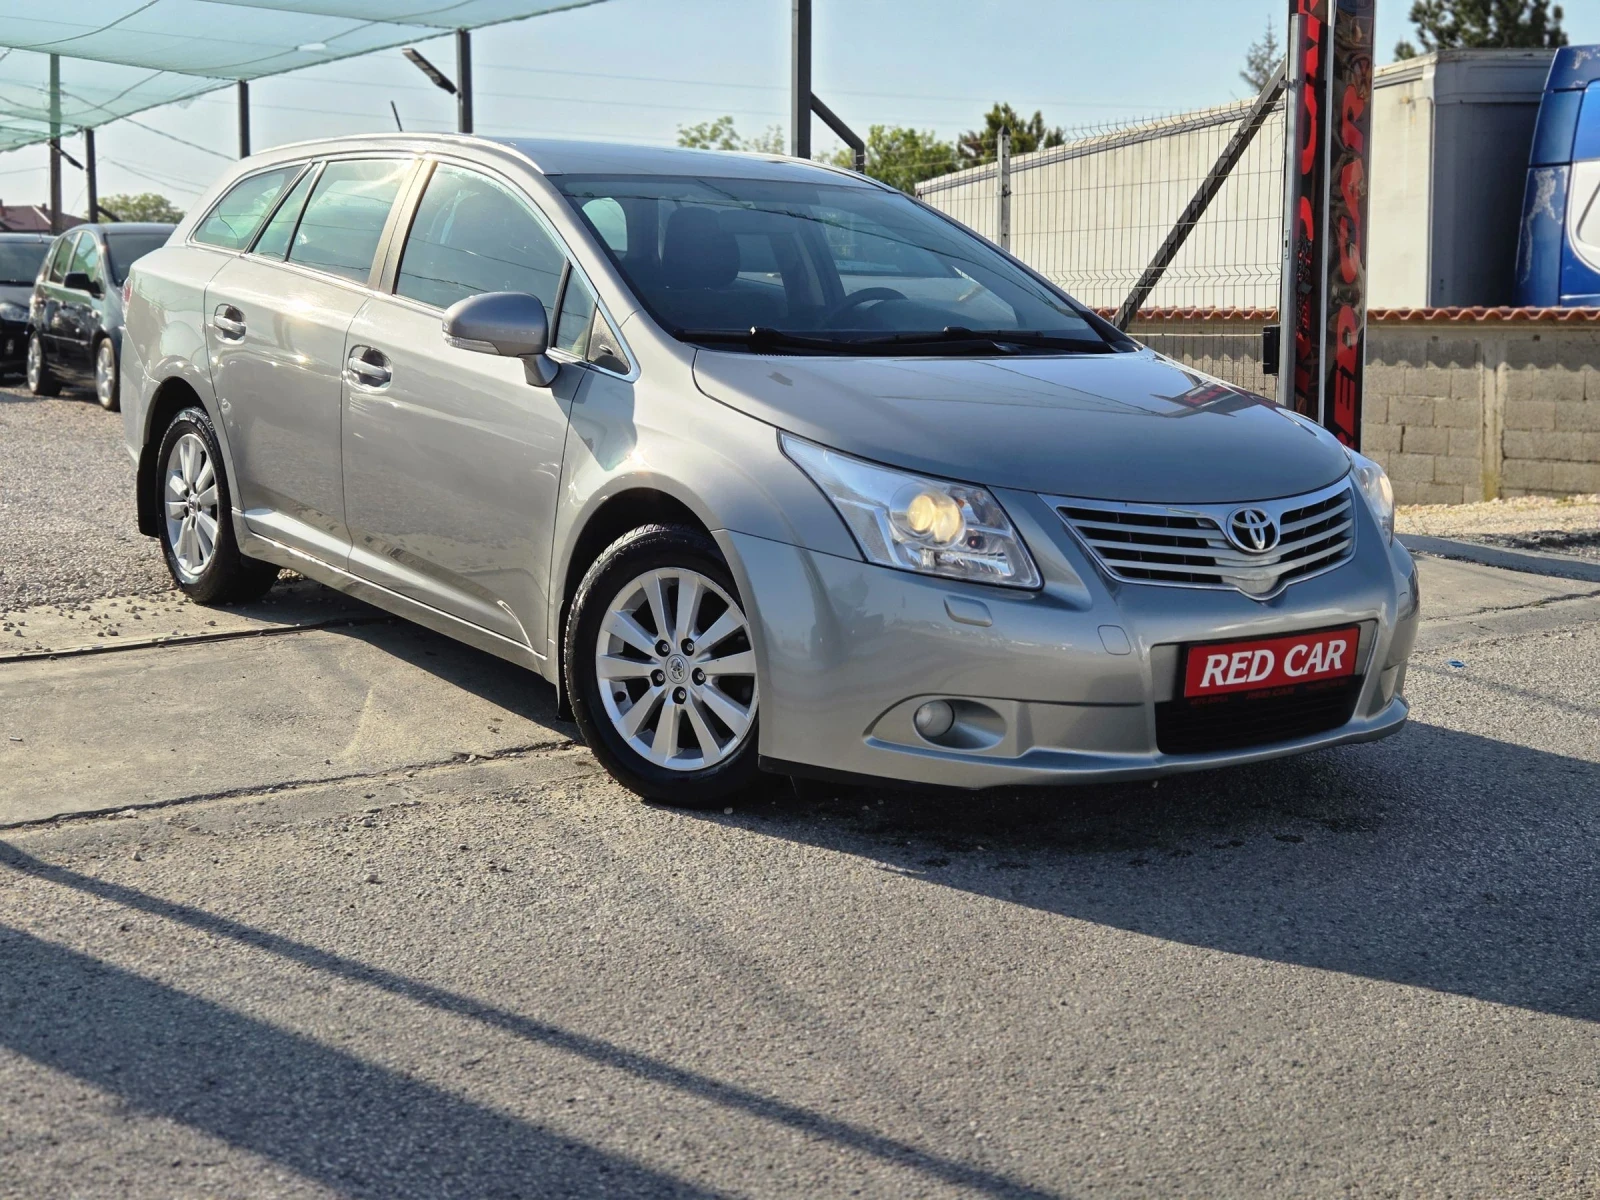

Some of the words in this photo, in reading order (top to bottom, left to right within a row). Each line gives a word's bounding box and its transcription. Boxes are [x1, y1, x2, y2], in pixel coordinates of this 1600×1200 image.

[1339, 84, 1364, 283] CAR
[1200, 649, 1275, 688] RED
[1283, 639, 1347, 678] CAR
